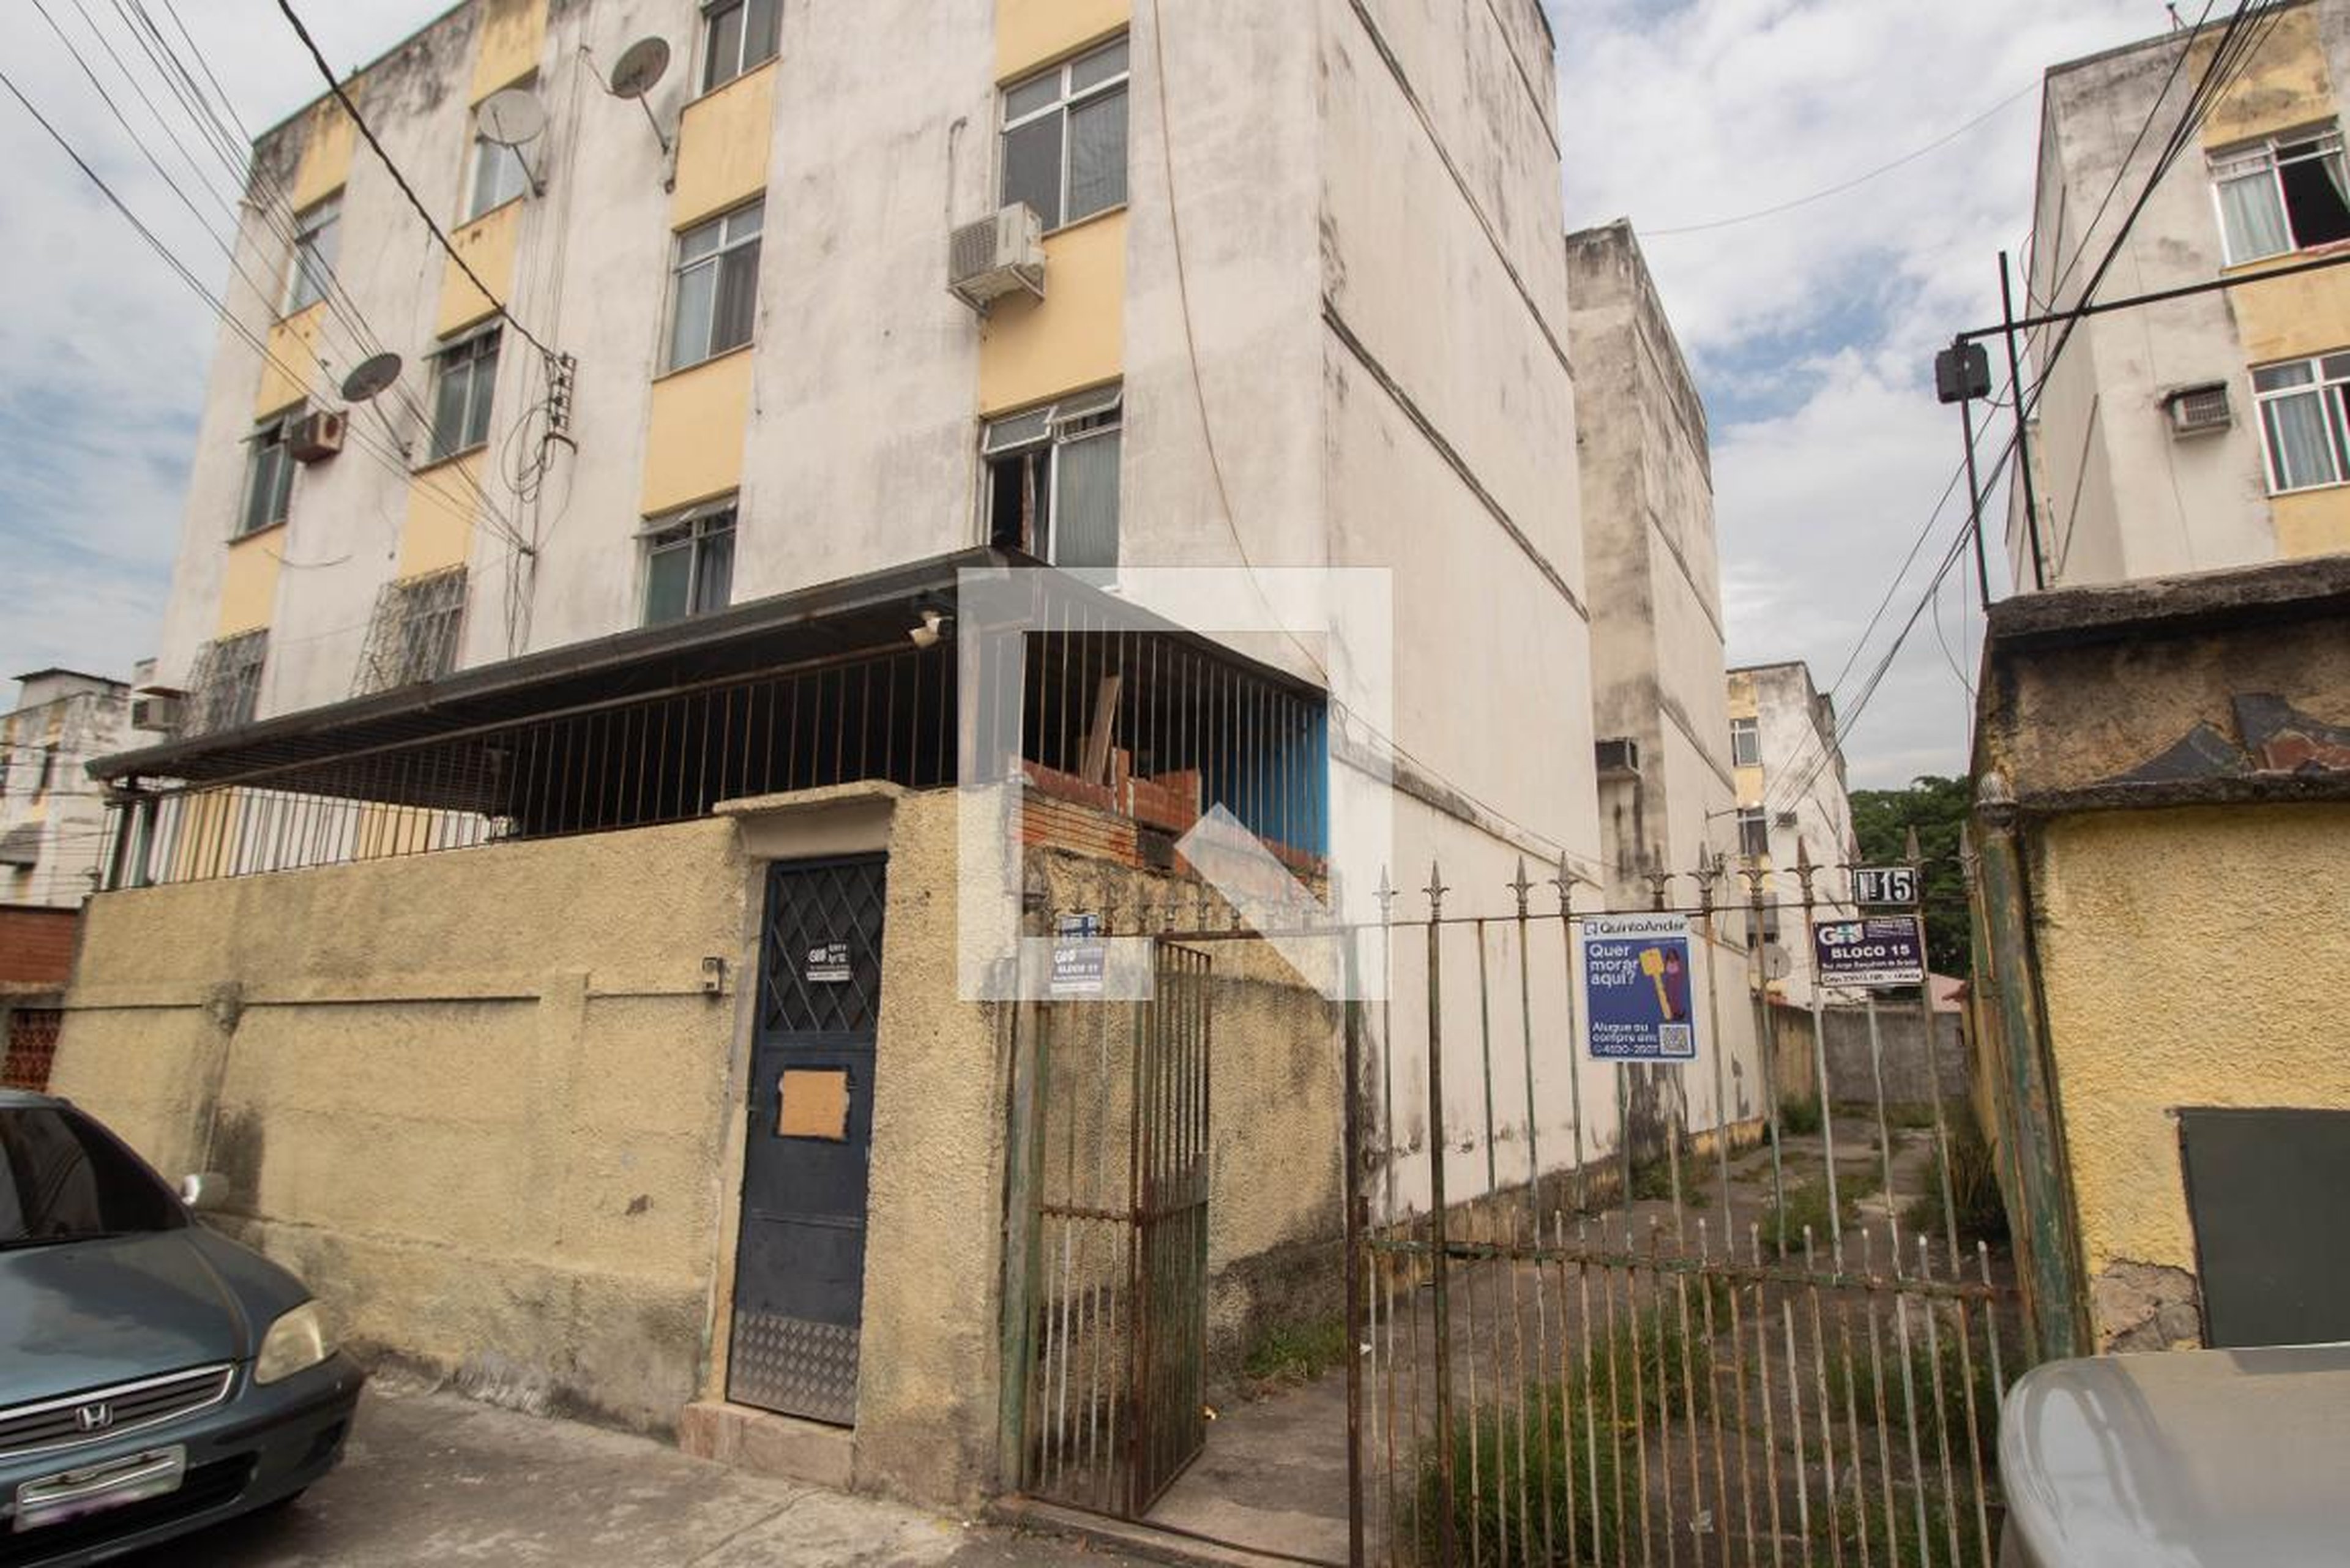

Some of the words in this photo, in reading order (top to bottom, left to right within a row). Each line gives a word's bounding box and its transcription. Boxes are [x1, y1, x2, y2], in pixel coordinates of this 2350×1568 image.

[1880, 870, 1911, 902] 15
[1589, 944, 1630, 957] Quer
[1831, 946, 1886, 958] BLOCO
[1891, 944, 1910, 956] 15
[1591, 959, 1639, 971] morar
[1591, 971, 1635, 988] aqui?
